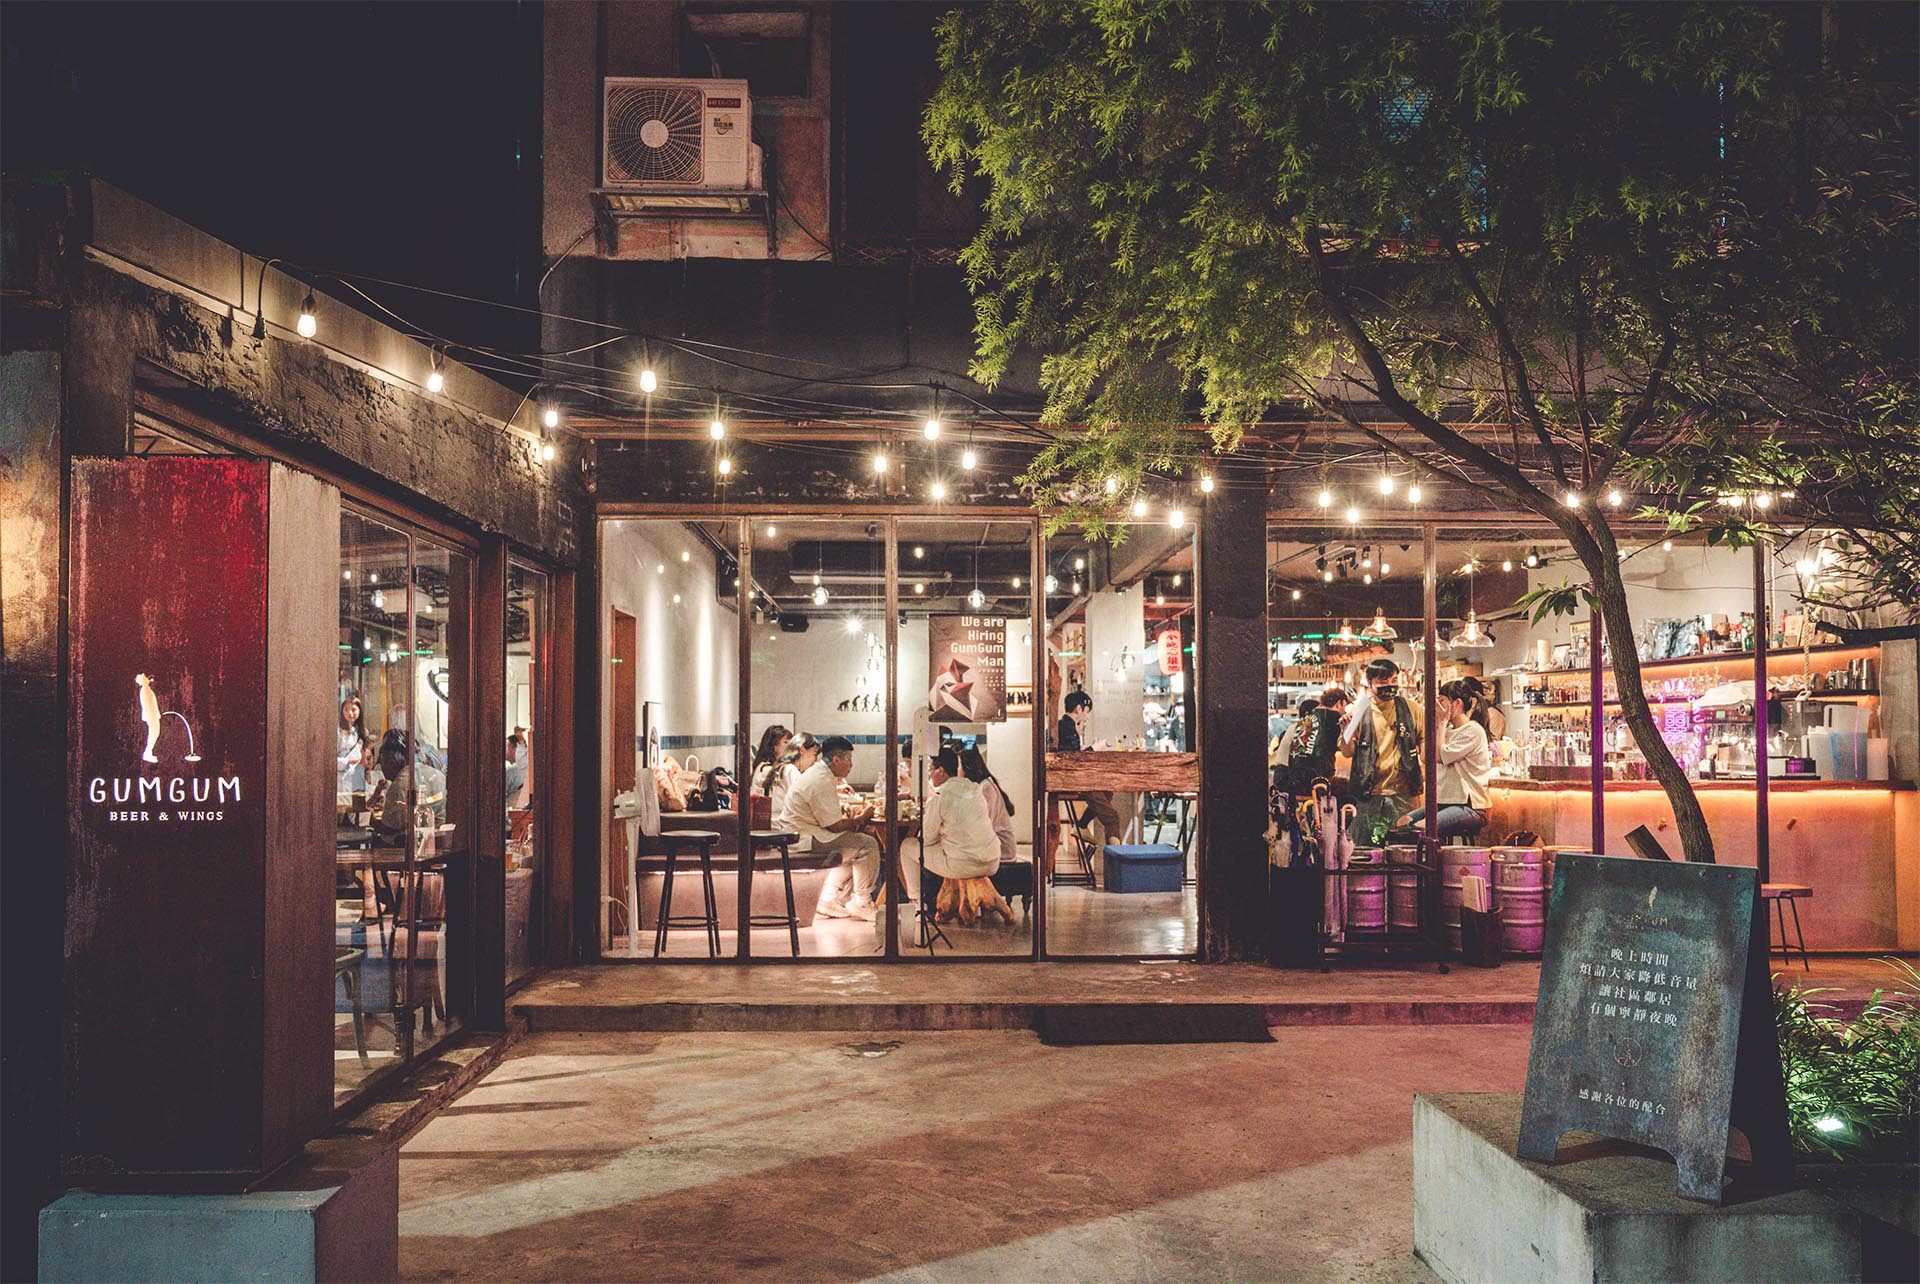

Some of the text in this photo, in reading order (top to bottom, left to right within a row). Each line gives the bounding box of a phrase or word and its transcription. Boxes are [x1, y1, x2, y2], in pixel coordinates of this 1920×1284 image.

[961, 616, 1004, 627] We are
[968, 630, 1004, 643] Hiring
[951, 643, 1004, 653] GumGum
[977, 656, 1004, 666] Man
[1304, 729, 1319, 755] TOUR
[89, 776, 241, 804] GUMGUM
[110, 811, 224, 821] BEER & WINGS
[1610, 948, 1669, 967] 晚上時間
